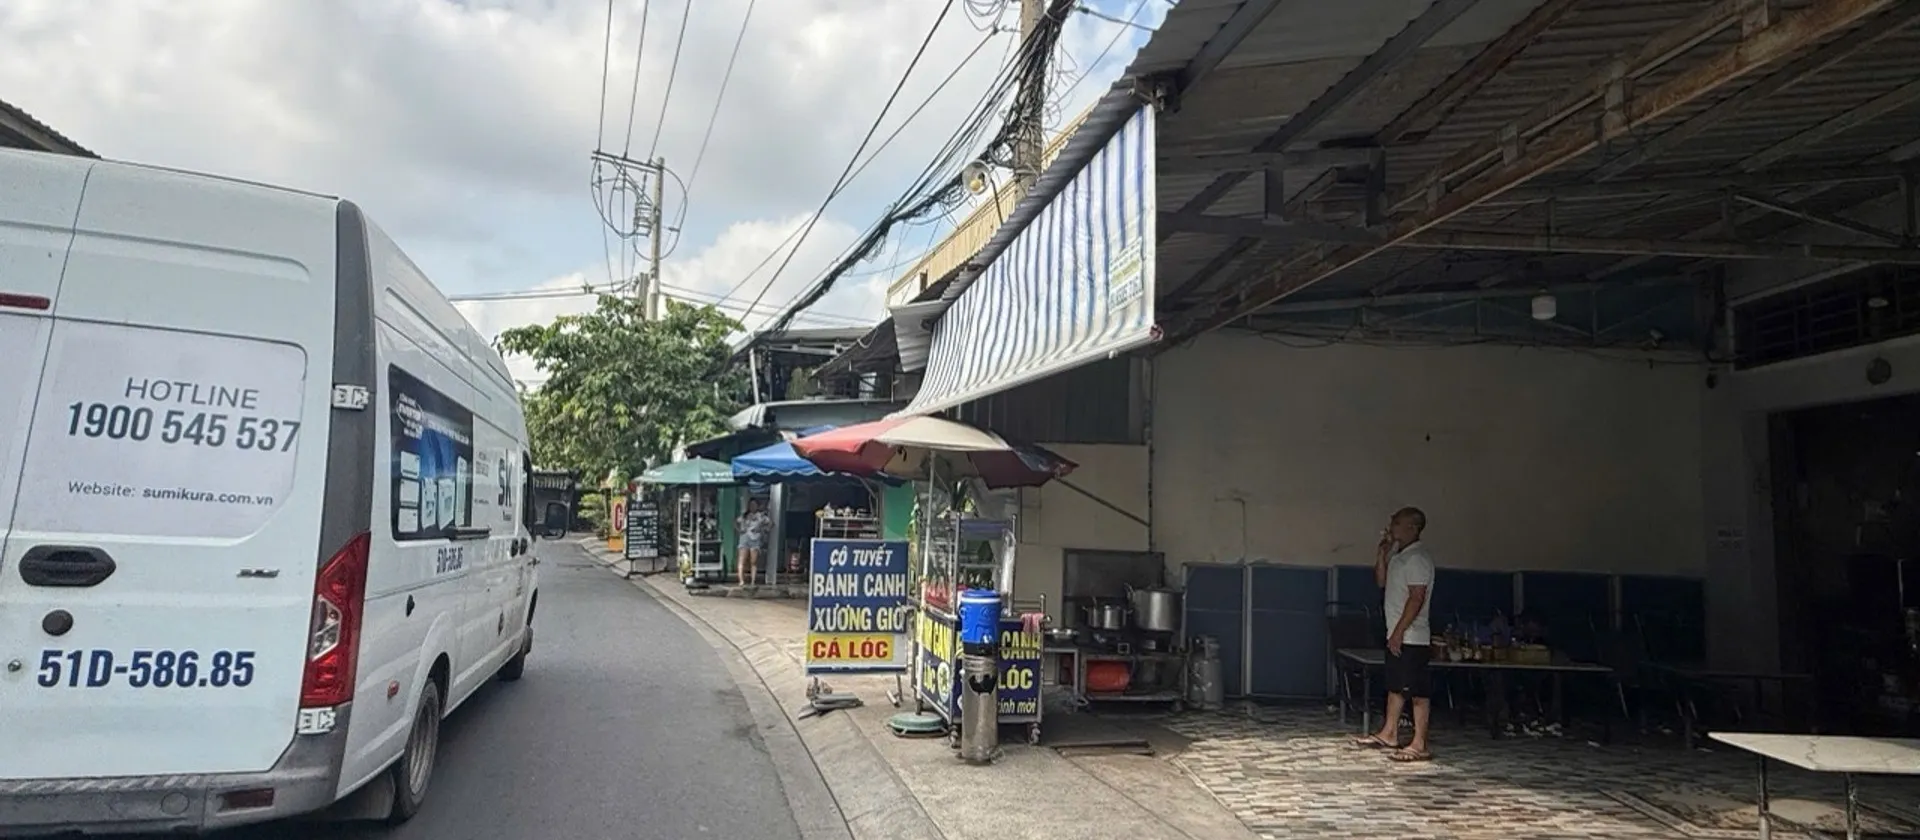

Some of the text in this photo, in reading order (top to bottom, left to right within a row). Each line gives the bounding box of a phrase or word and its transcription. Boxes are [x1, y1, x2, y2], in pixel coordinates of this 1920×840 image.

[124, 377, 260, 410] HOTLINE
[67, 402, 301, 453] 1900 545 537
[68, 481, 274, 506] Website: sumikura.com.vn
[829, 543, 893, 567] CÔ TUYẾT
[813, 567, 858, 597] BÁNH
[863, 573, 905, 597] CANH
[813, 603, 872, 631] XƯƠNG
[813, 637, 888, 658] CÁ LÓC
[36, 650, 256, 689] 51D-586.85
[998, 697, 1015, 714] ính
